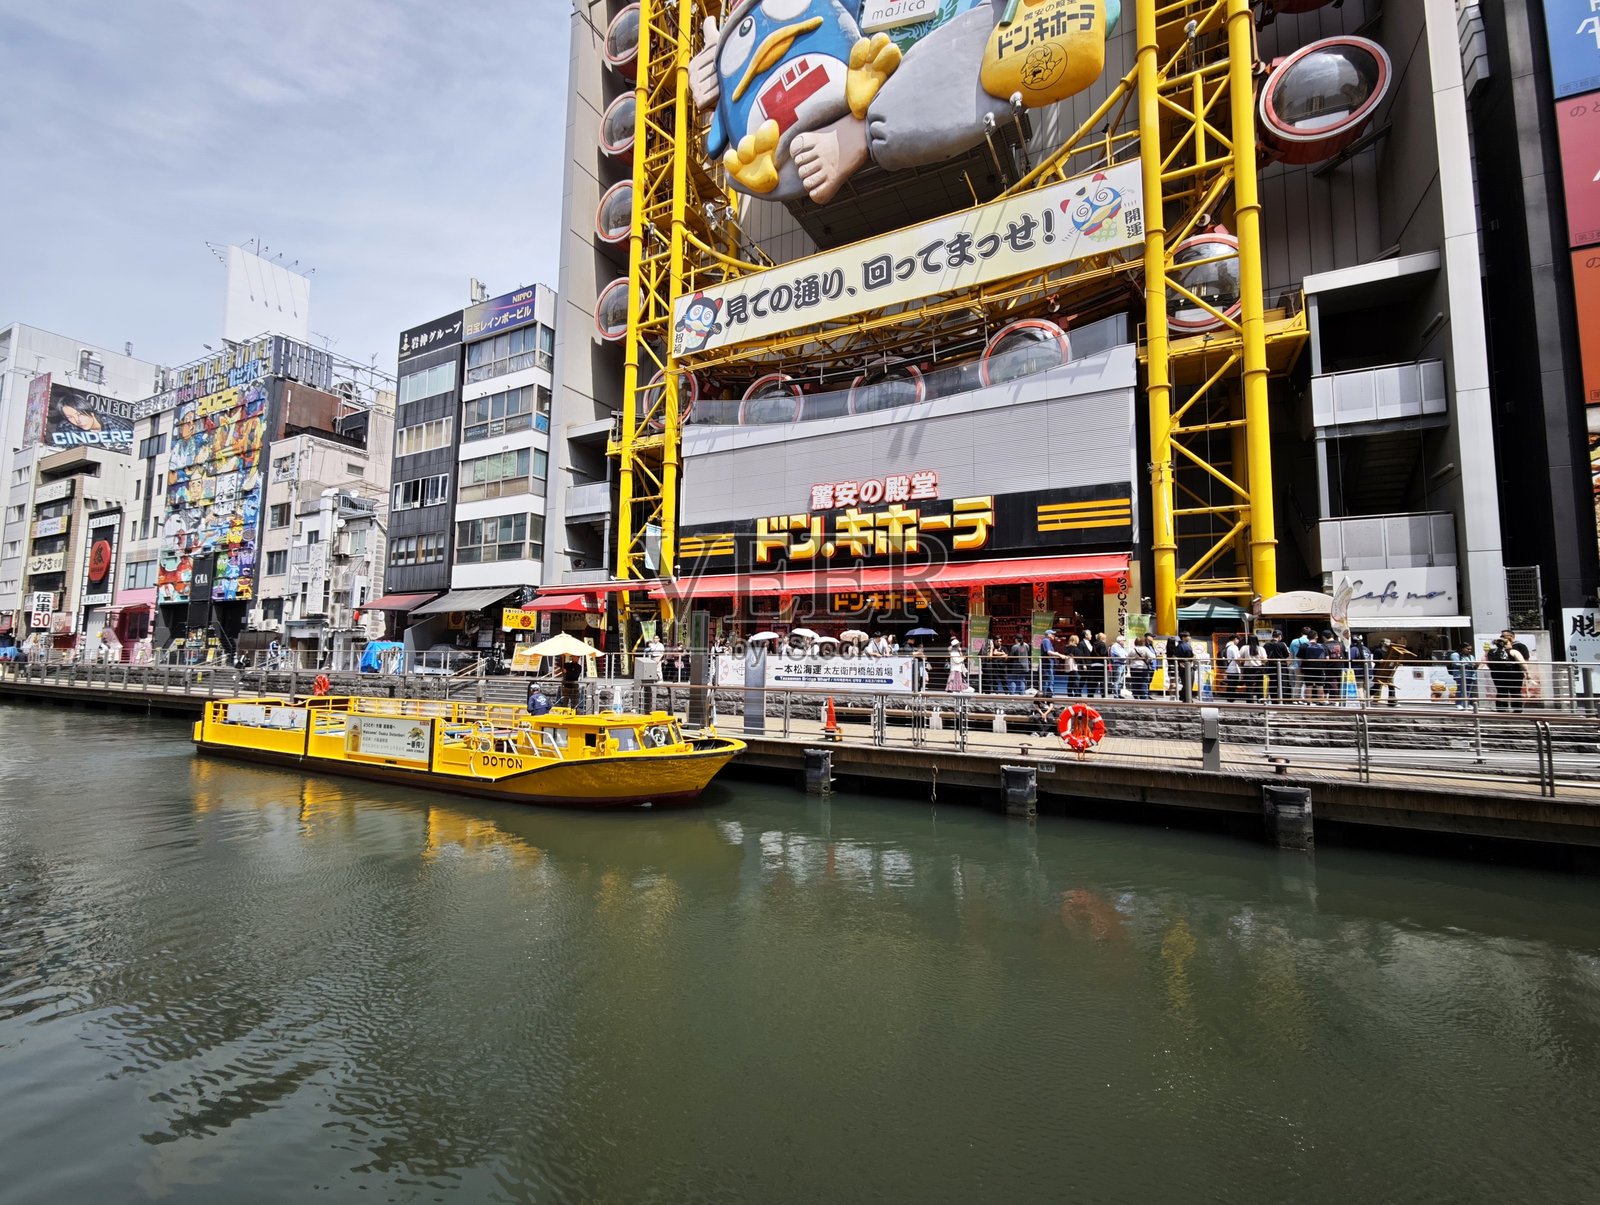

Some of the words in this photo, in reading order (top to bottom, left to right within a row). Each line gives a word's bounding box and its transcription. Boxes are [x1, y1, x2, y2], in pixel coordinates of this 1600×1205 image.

[1124, 207, 1144, 239] 開運
[512, 290, 533, 304] NIPPO
[466, 305, 532, 336] 日宝レインボービル
[811, 470, 939, 510] 驚安の殿堂
[36, 594, 52, 612] 伝串
[32, 613, 51, 627] 50
[775, 664, 822, 675] 一本松海運
[482, 755, 523, 769] DOTON
